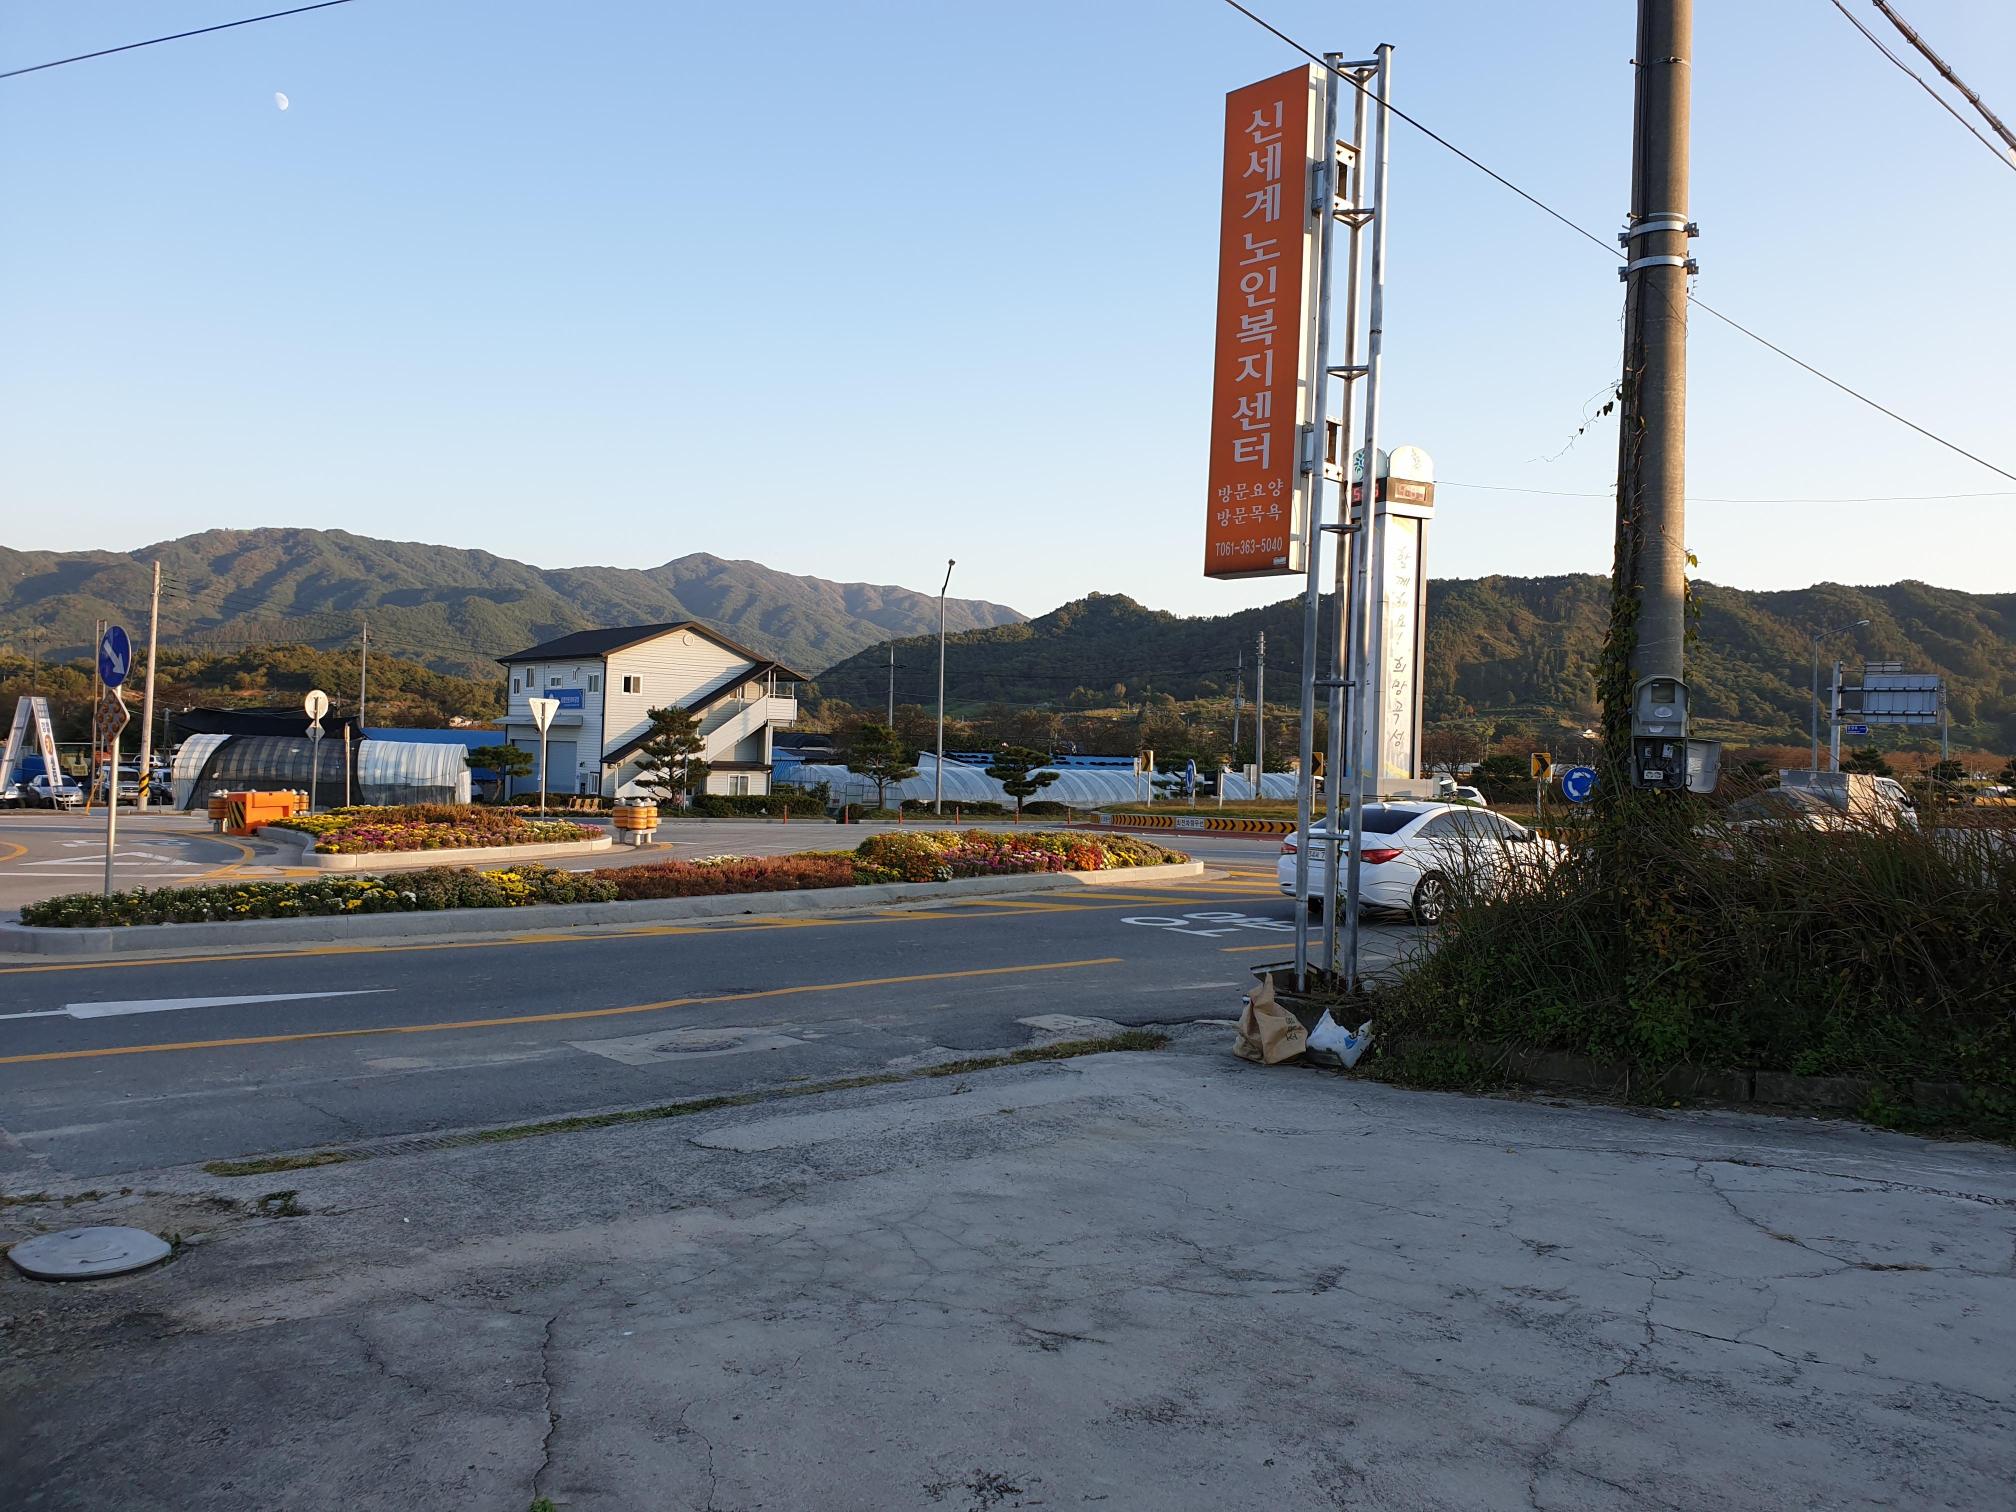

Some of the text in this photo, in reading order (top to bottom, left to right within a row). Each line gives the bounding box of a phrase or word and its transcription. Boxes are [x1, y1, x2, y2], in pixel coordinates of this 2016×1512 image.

[1217, 478, 1284, 503] 방문요양
[1216, 503, 1283, 527] 방문목욕
[1215, 536, 1283, 557] T061-363-5040
